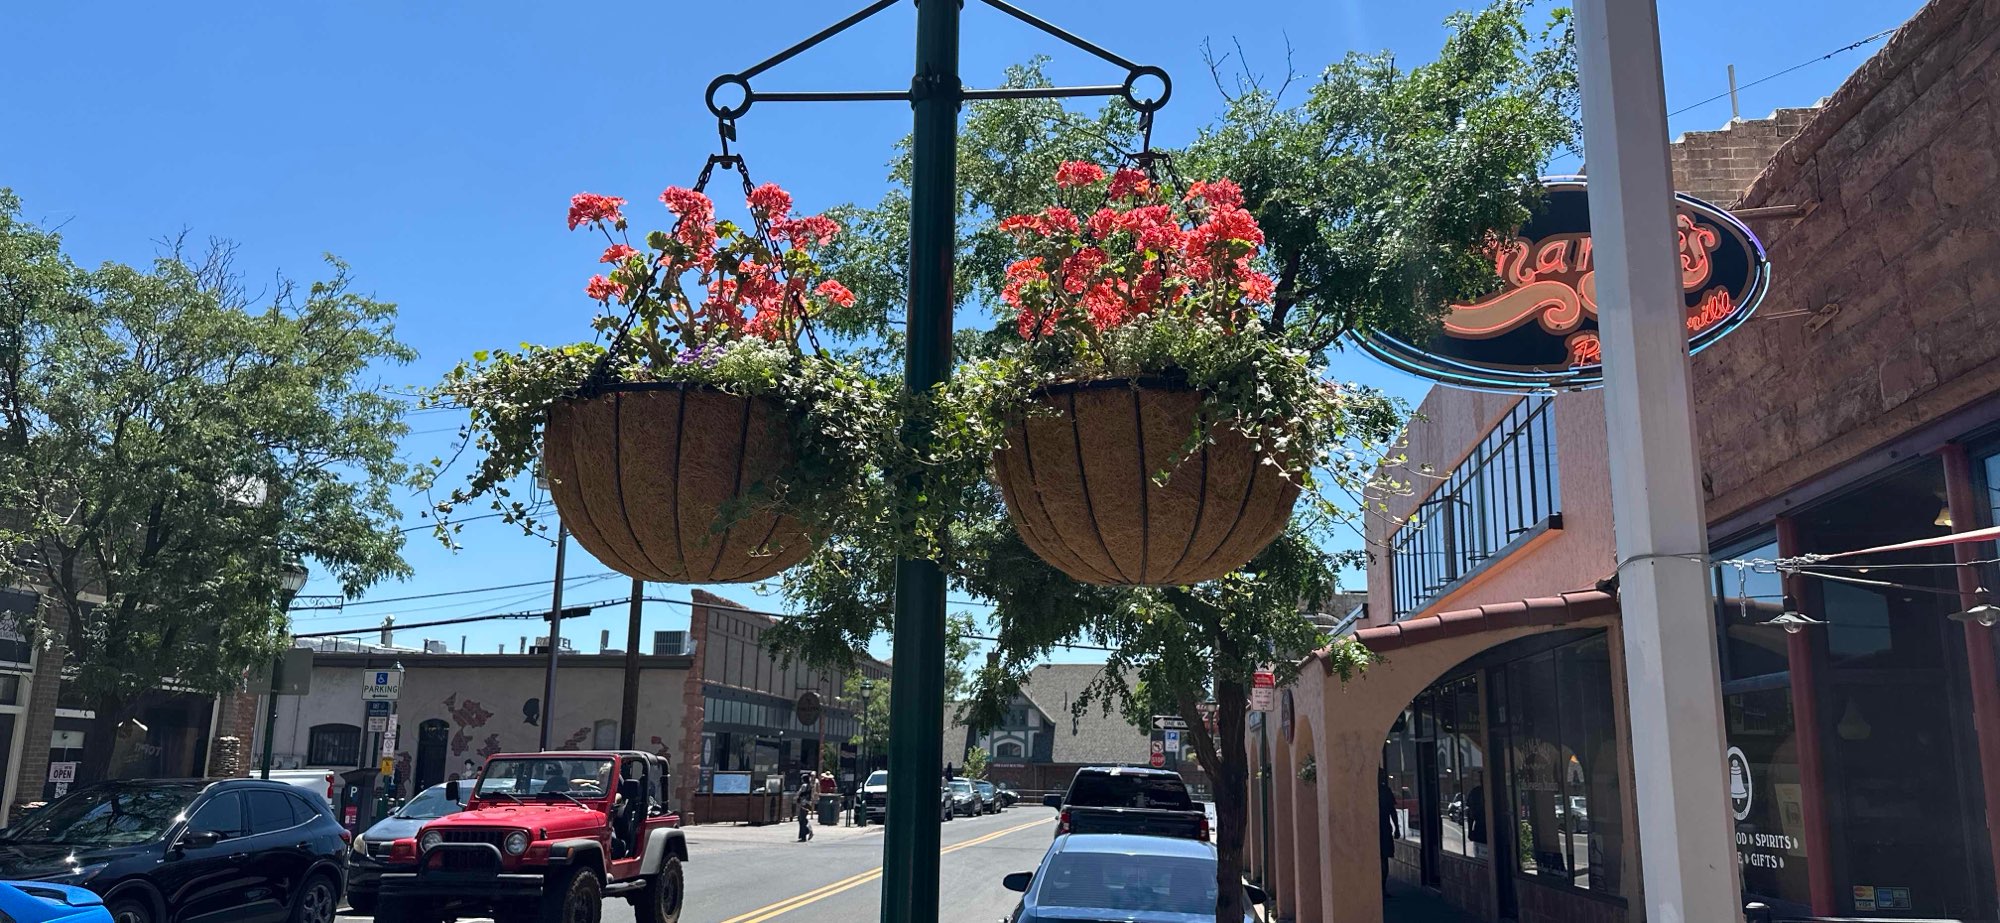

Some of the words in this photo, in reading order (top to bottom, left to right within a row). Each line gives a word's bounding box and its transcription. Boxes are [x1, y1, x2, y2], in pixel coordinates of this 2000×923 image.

[364, 685, 398, 694] PARKING
[1151, 756, 1166, 764] STOP
[53, 769, 72, 779] OPEN
[350, 786, 358, 798] P
[1755, 833, 1792, 850] SPIRITS
[1751, 853, 1778, 869] GIFTS
